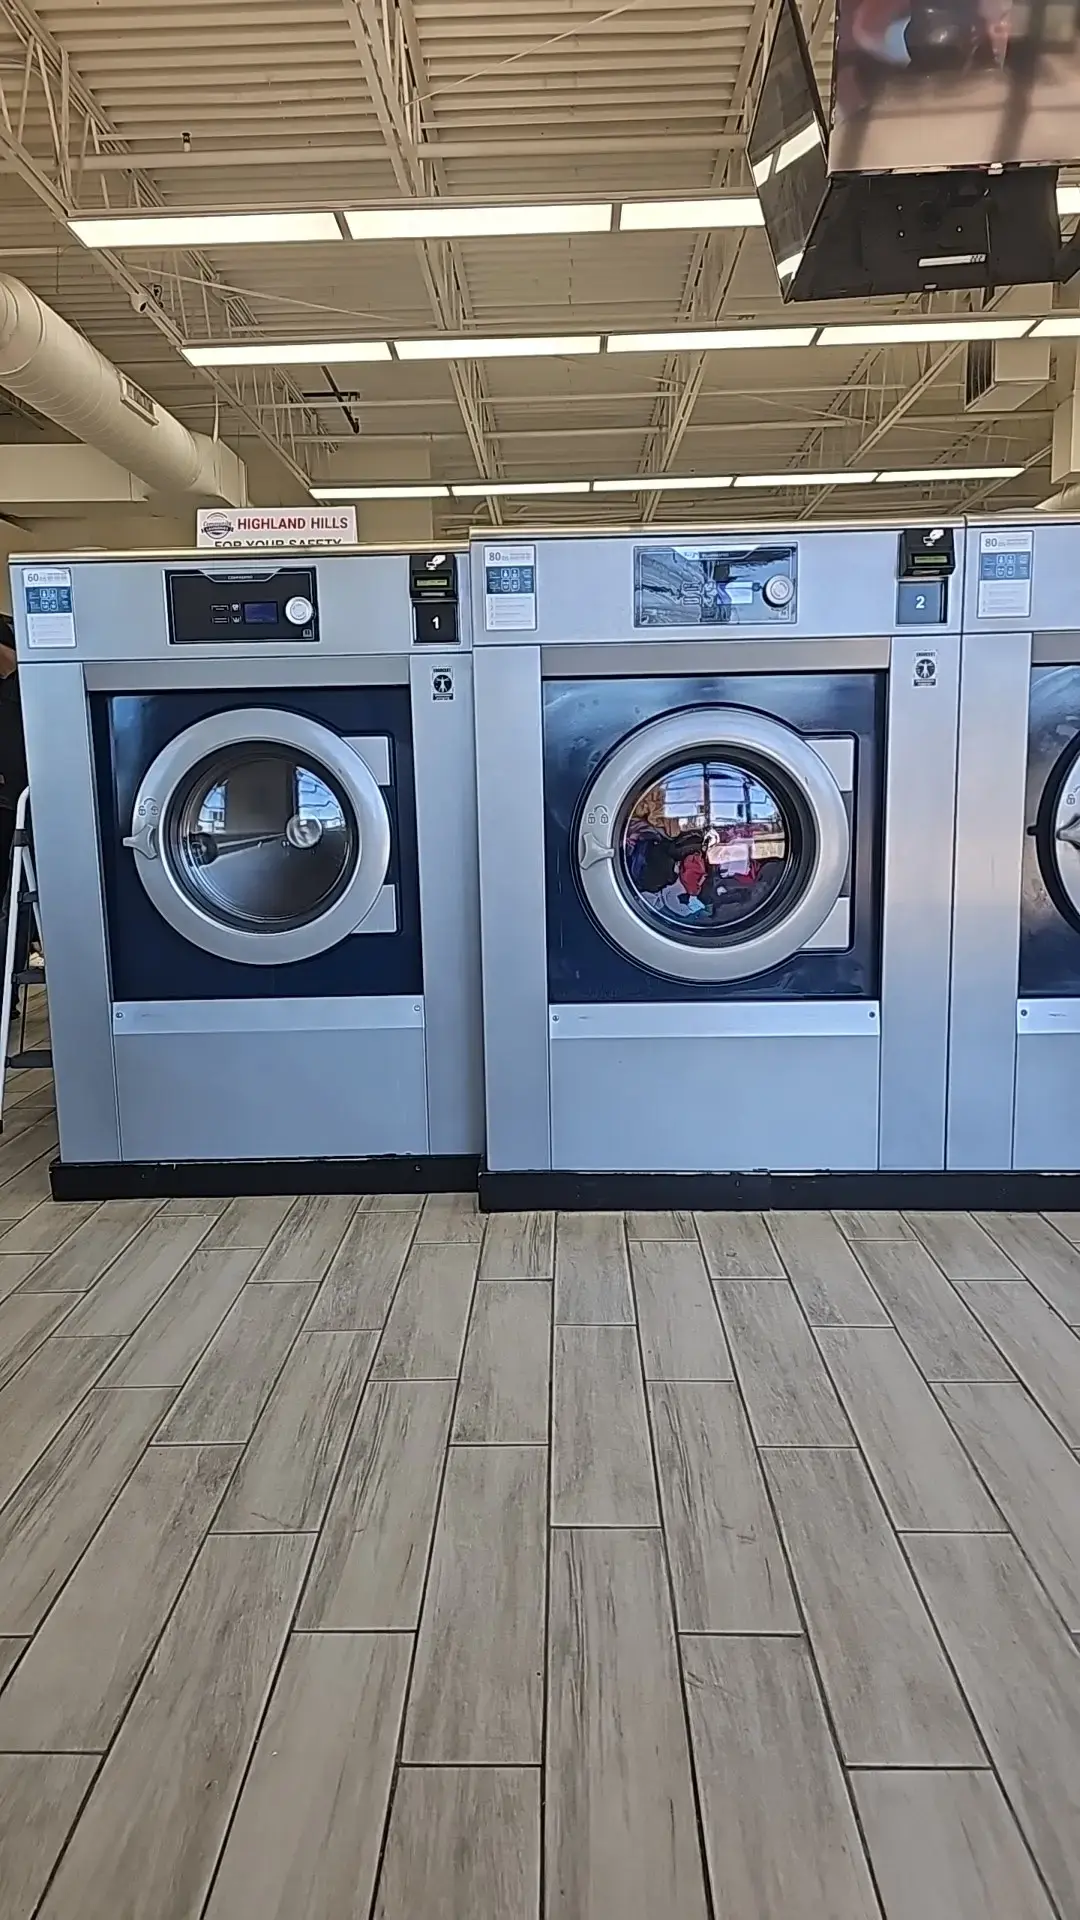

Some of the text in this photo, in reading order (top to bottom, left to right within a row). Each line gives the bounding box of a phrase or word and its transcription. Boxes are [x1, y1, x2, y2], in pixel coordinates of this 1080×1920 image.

[238, 518, 306, 530] HIGHLAND
[311, 517, 348, 529] HILLS
[985, 538, 997, 547] 80
[489, 552, 501, 561] 80
[27, 573, 39, 582] 60
[915, 596, 925, 609] 2
[432, 616, 440, 629] 1
